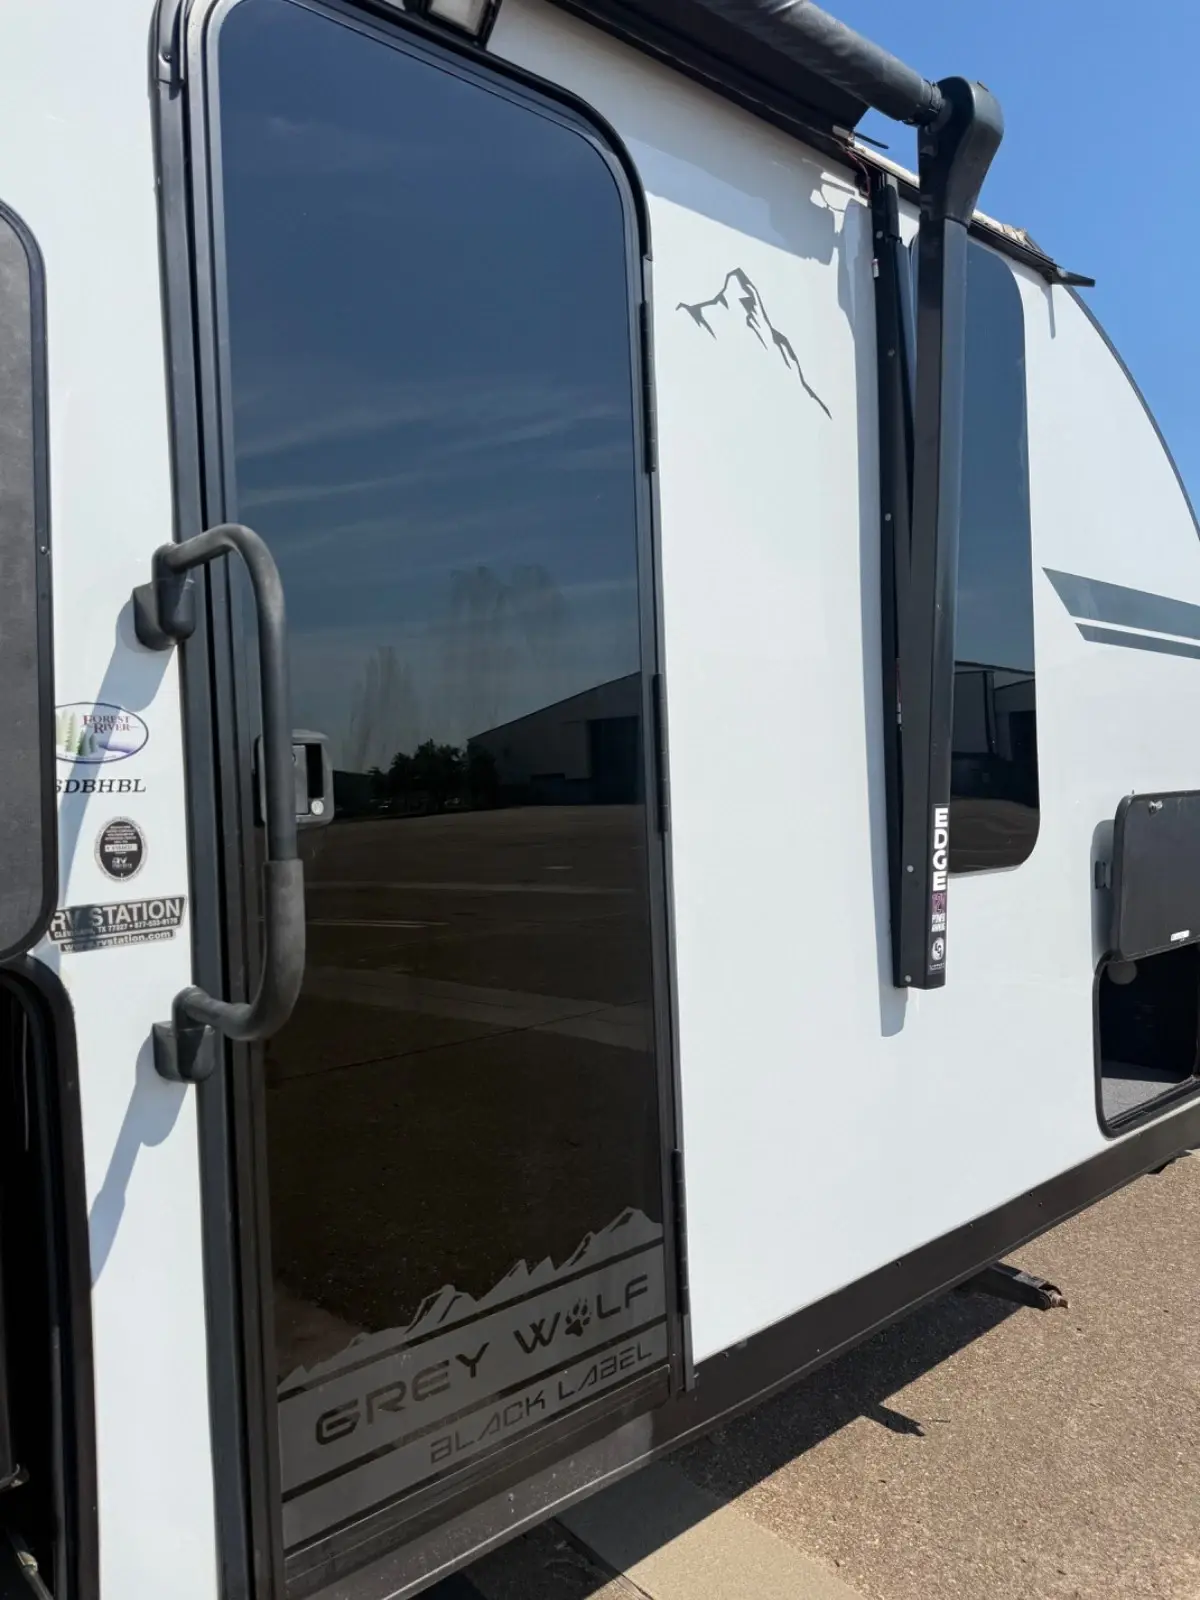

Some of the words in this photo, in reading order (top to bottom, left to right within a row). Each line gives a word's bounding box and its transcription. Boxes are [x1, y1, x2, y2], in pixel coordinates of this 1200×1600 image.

[83, 715, 129, 725] FOREST
[93, 723, 130, 734] RIVER
[933, 807, 949, 891] EDGE
[50, 911, 81, 931] RV
[90, 899, 180, 926] STATION
[315, 1342, 490, 1445] GREY
[431, 1389, 546, 1464] BLACK
[558, 1342, 653, 1401] LABEL
